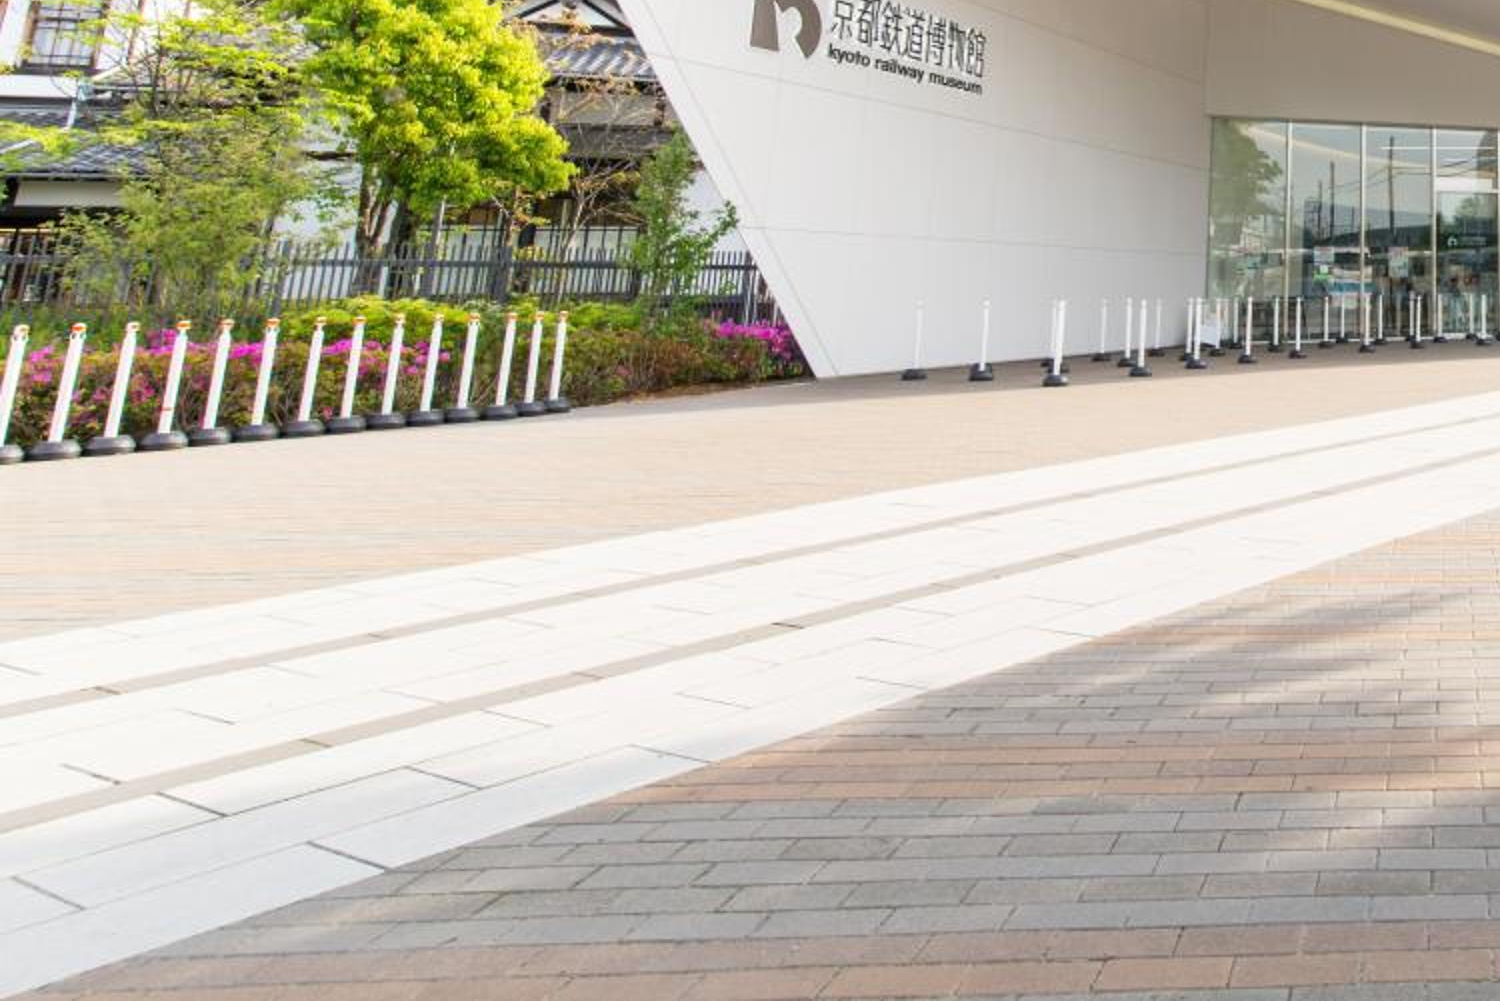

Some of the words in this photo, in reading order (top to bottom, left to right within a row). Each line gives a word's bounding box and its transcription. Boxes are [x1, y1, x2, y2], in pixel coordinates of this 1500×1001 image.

[828, 43, 871, 67] kyoto
[875, 57, 925, 83] railway
[929, 71, 983, 95] museum
